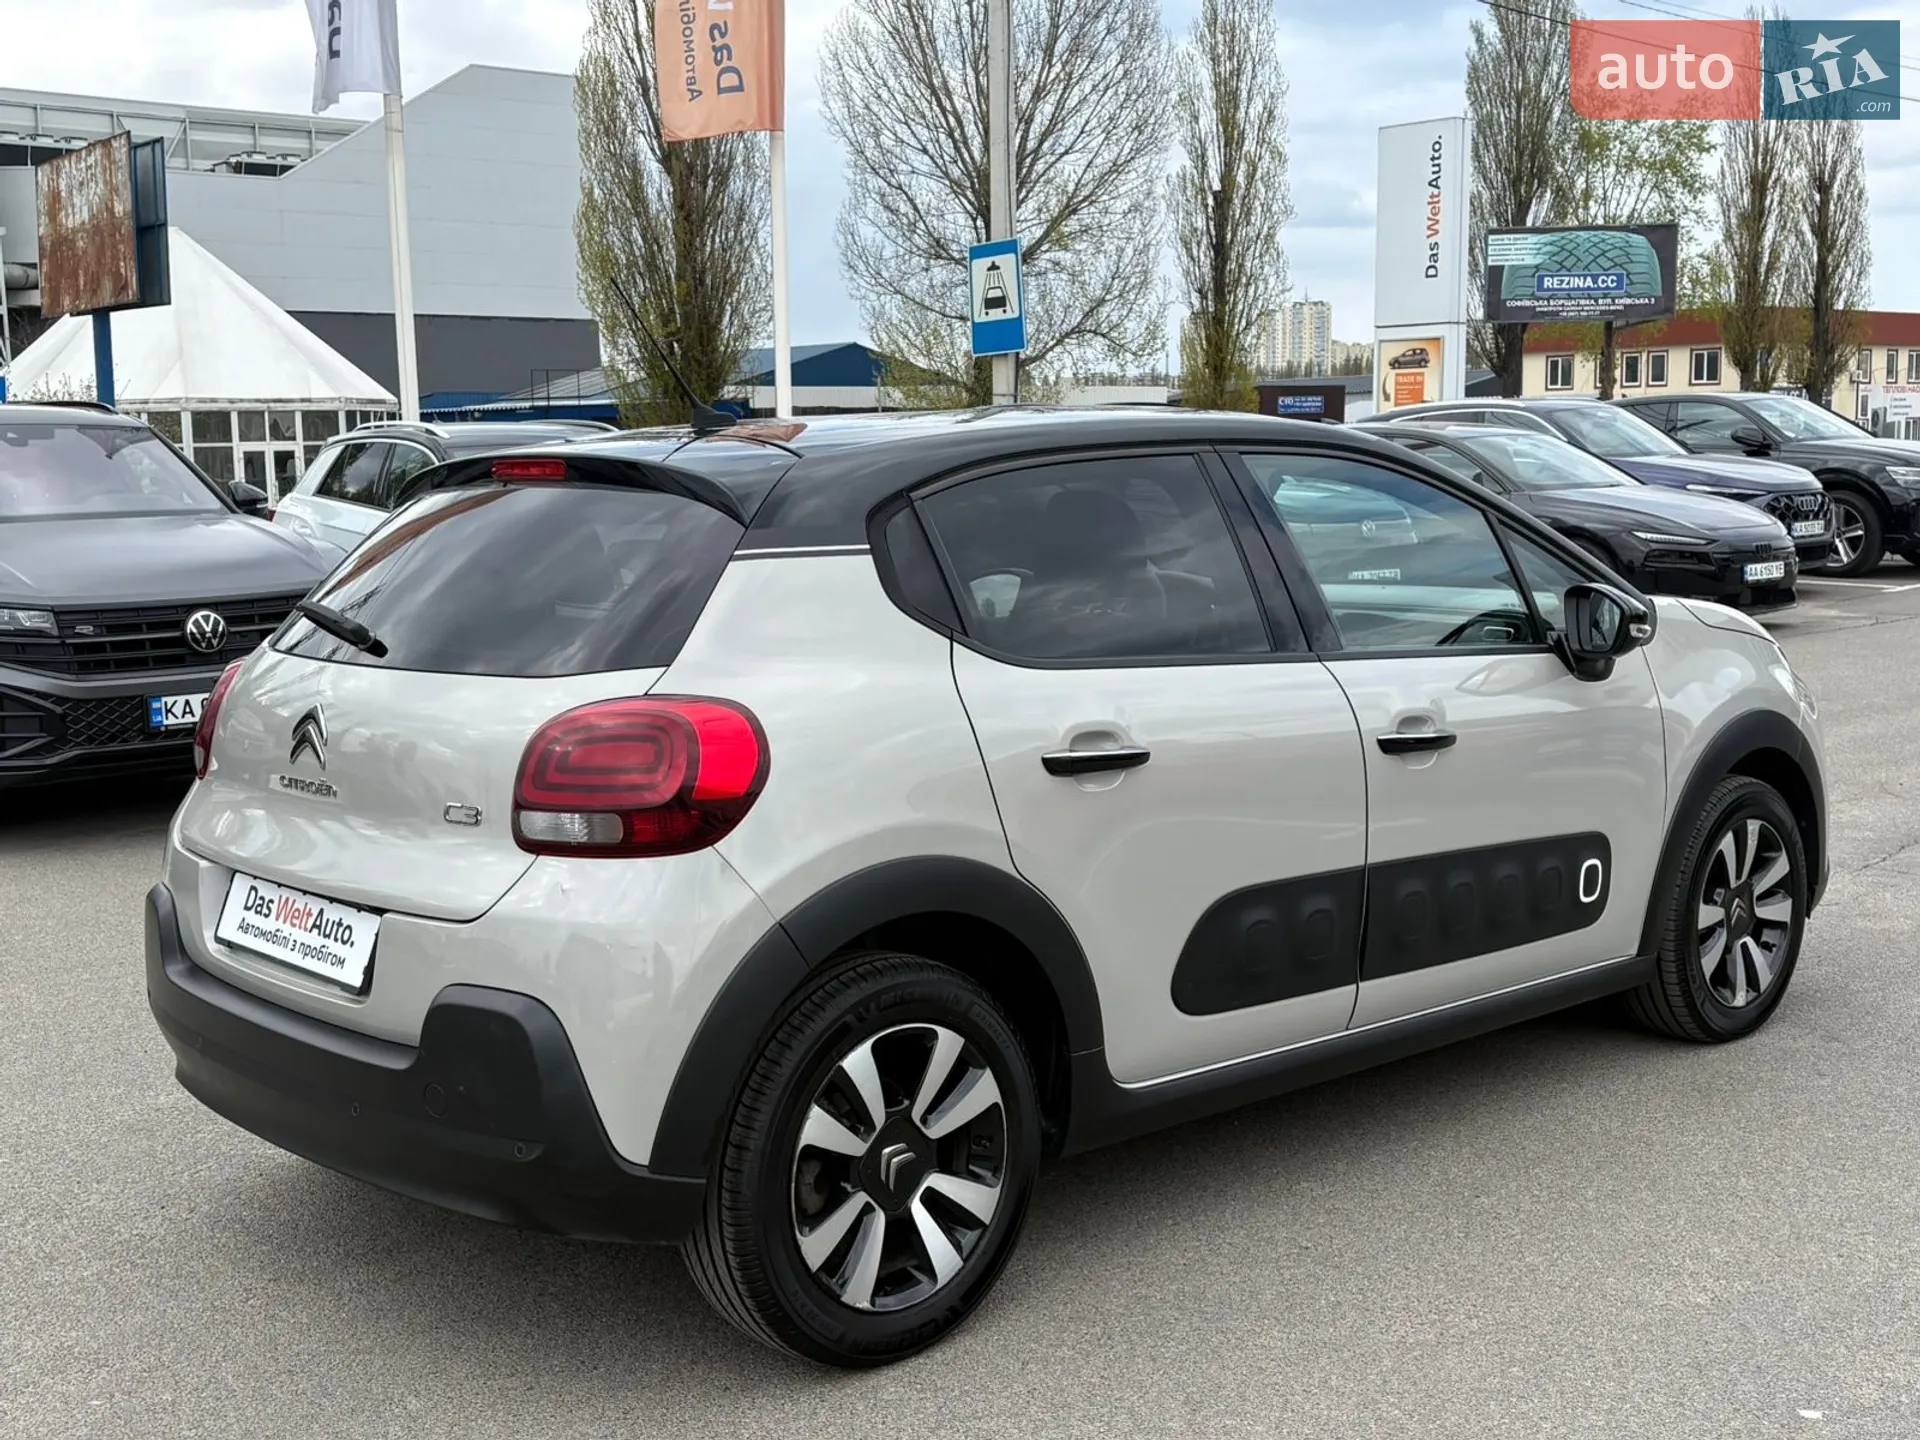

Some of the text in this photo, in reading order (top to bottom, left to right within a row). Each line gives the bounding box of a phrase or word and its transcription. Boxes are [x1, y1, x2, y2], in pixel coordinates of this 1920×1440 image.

[1424, 241, 1440, 279] Das
[1543, 275, 1618, 289] REZINA.CC
[164, 699, 196, 721] KA
[443, 802, 482, 827] C3
[243, 885, 275, 919] Das
[236, 917, 346, 970] Автомобілі з пробігом
